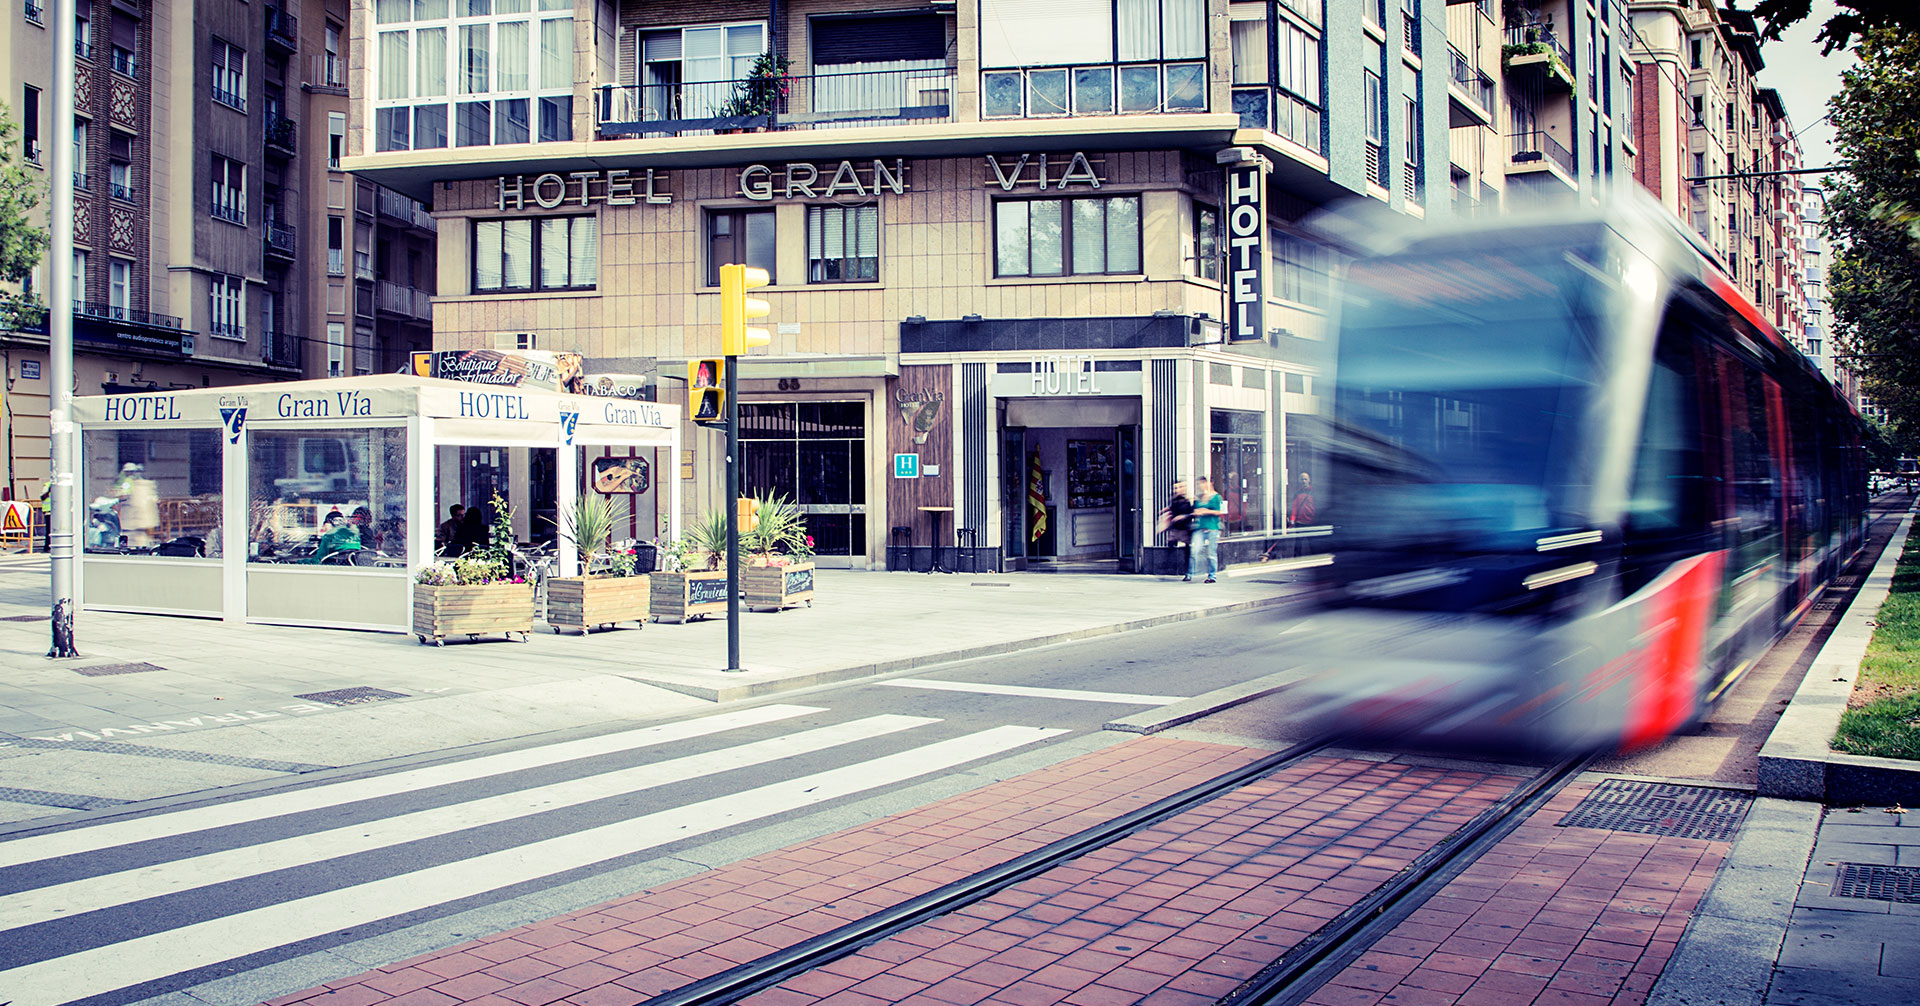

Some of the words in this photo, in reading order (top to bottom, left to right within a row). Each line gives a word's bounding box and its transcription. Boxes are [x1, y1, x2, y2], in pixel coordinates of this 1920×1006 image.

[494, 168, 673, 210] HOTEL
[738, 158, 905, 200] GRAN
[987, 151, 1102, 192] VIA
[1230, 170, 1259, 336] HOTEL
[440, 354, 498, 374] Boutique
[1031, 355, 1101, 395] HOTEL
[219, 395, 236, 407] Gran
[583, 383, 637, 397] TABACO
[104, 396, 181, 421] HOTEL
[277, 393, 330, 418] Gran
[337, 389, 372, 416] Vía
[459, 391, 529, 421] HOTEL
[604, 402, 638, 425] Gran
[640, 402, 662, 426] Vía
[901, 456, 912, 469] H
